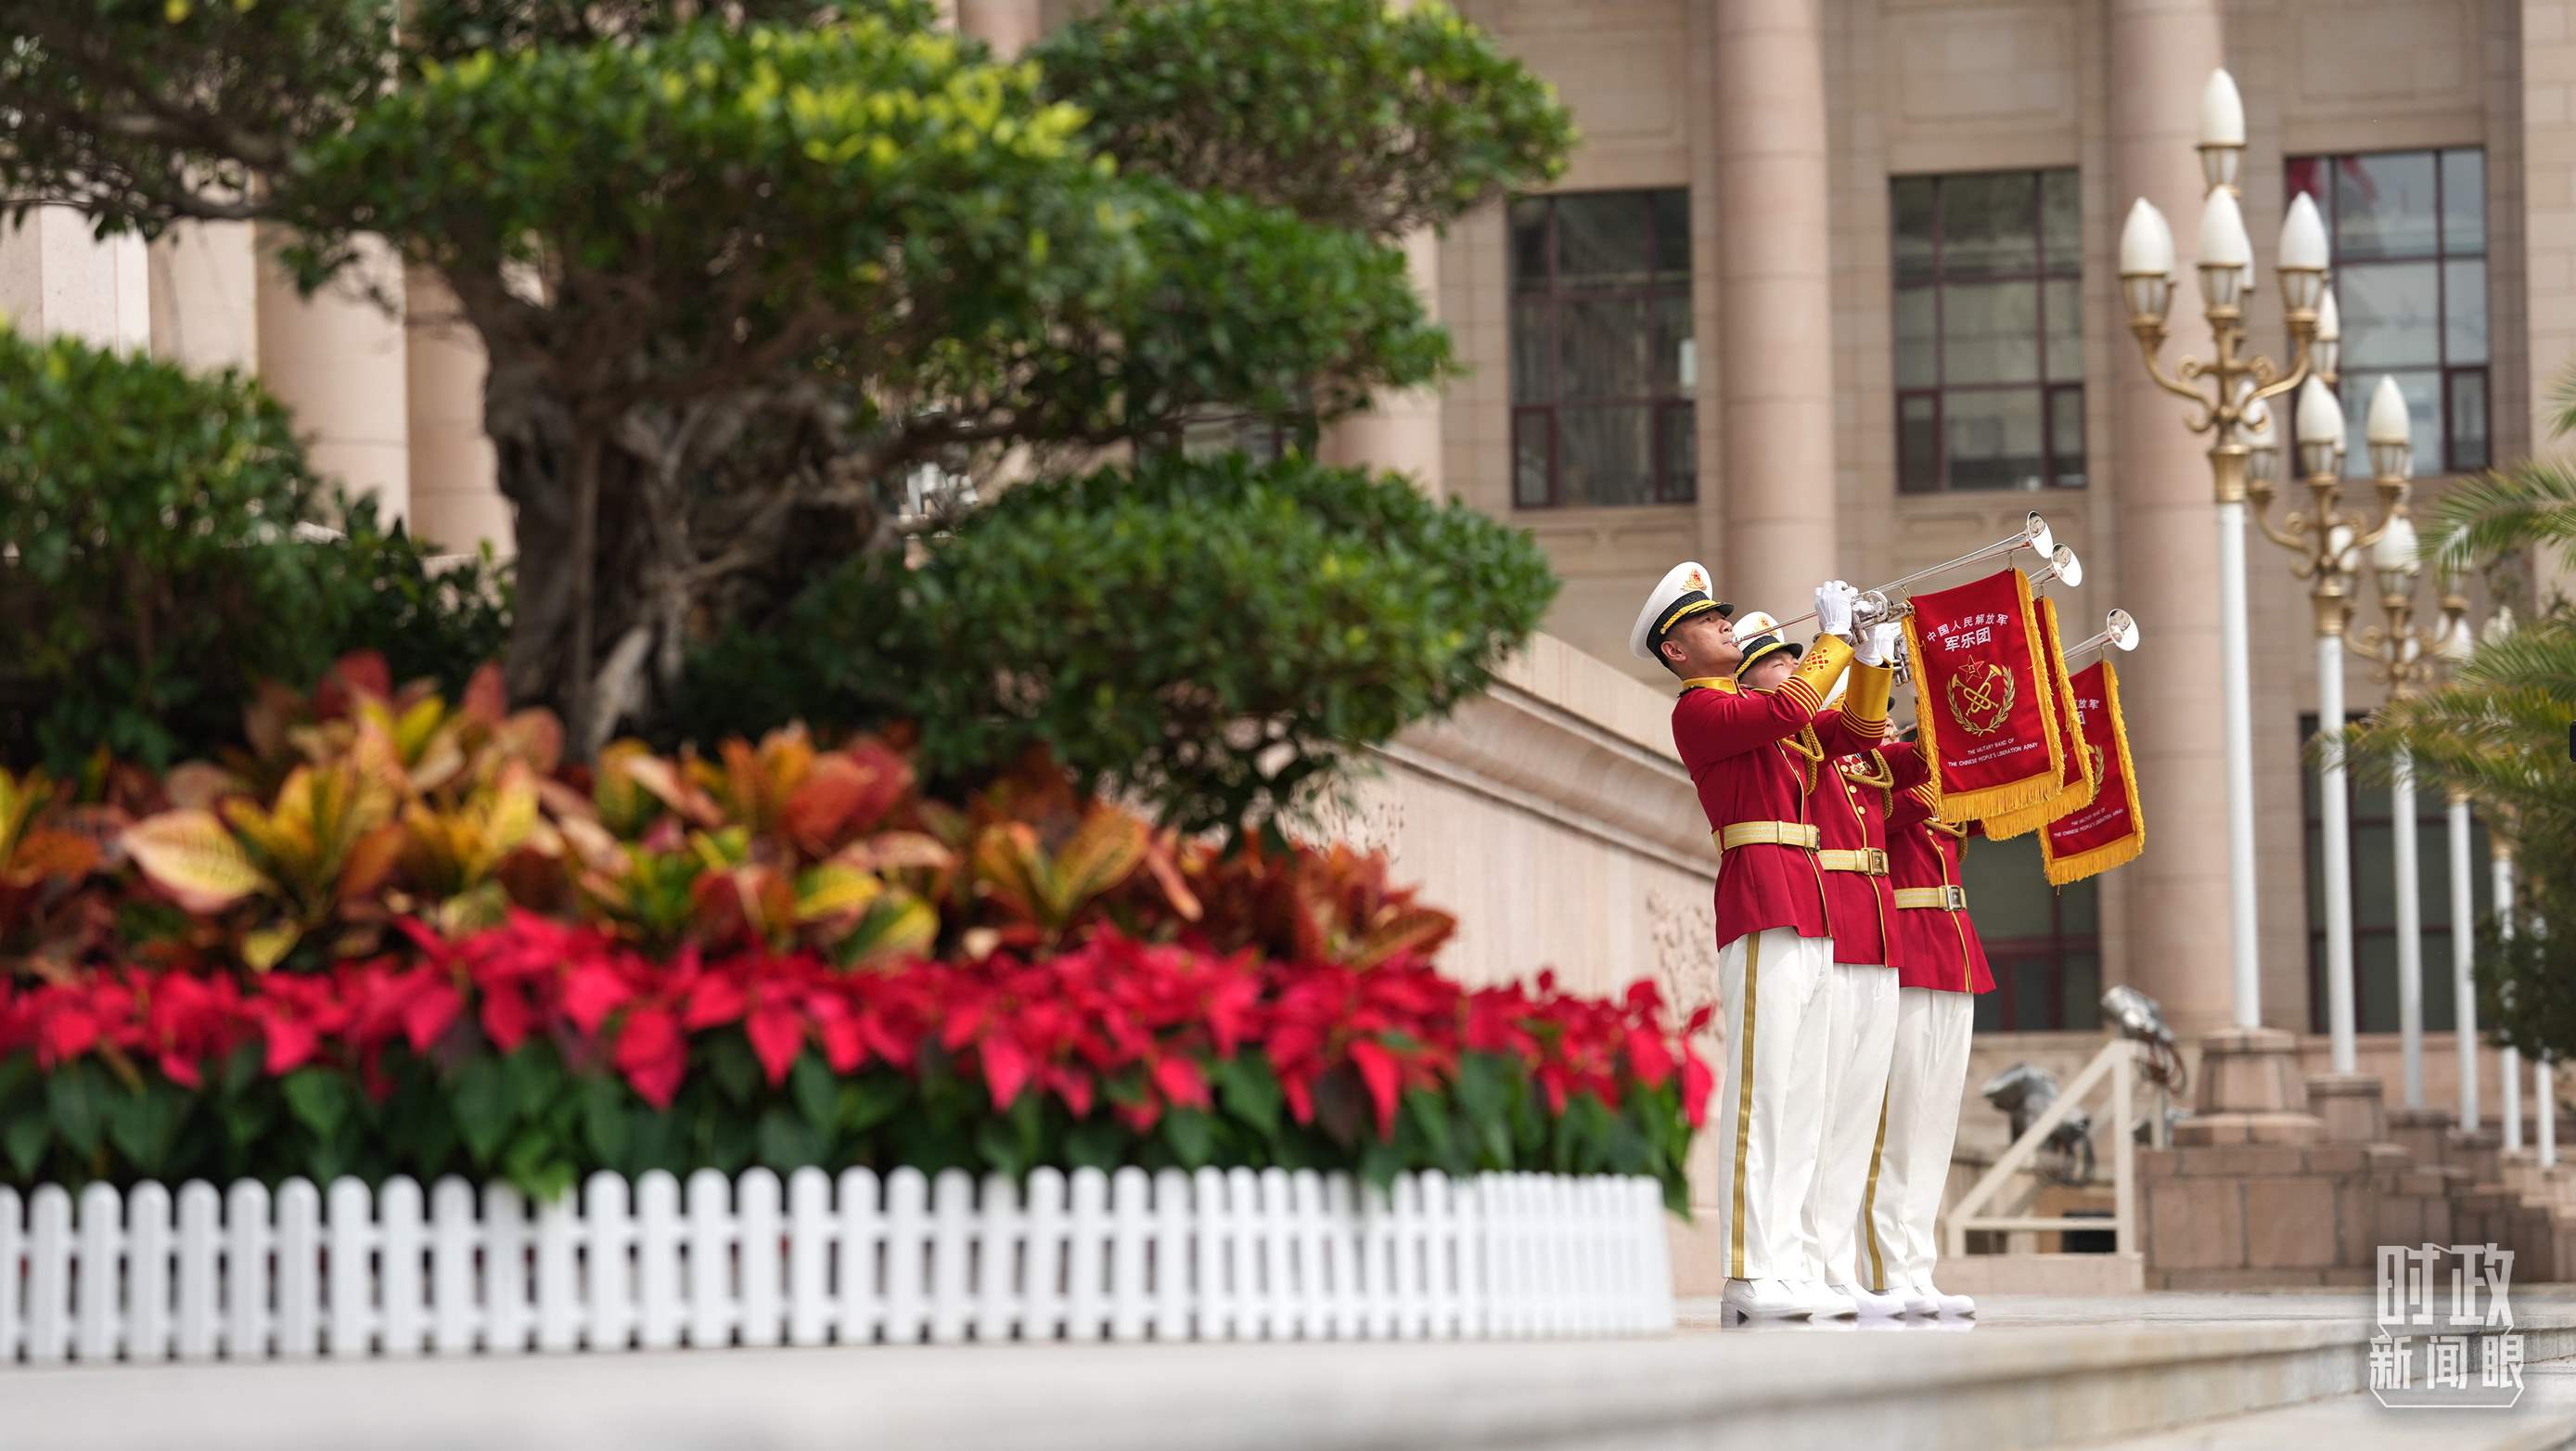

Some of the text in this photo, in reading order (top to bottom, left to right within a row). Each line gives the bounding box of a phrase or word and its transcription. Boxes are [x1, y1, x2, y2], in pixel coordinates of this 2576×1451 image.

[1927, 612, 2008, 642] 中国人民解放军
[1944, 626, 1992, 652] 军乐团
[2076, 698, 2099, 710] 放军
